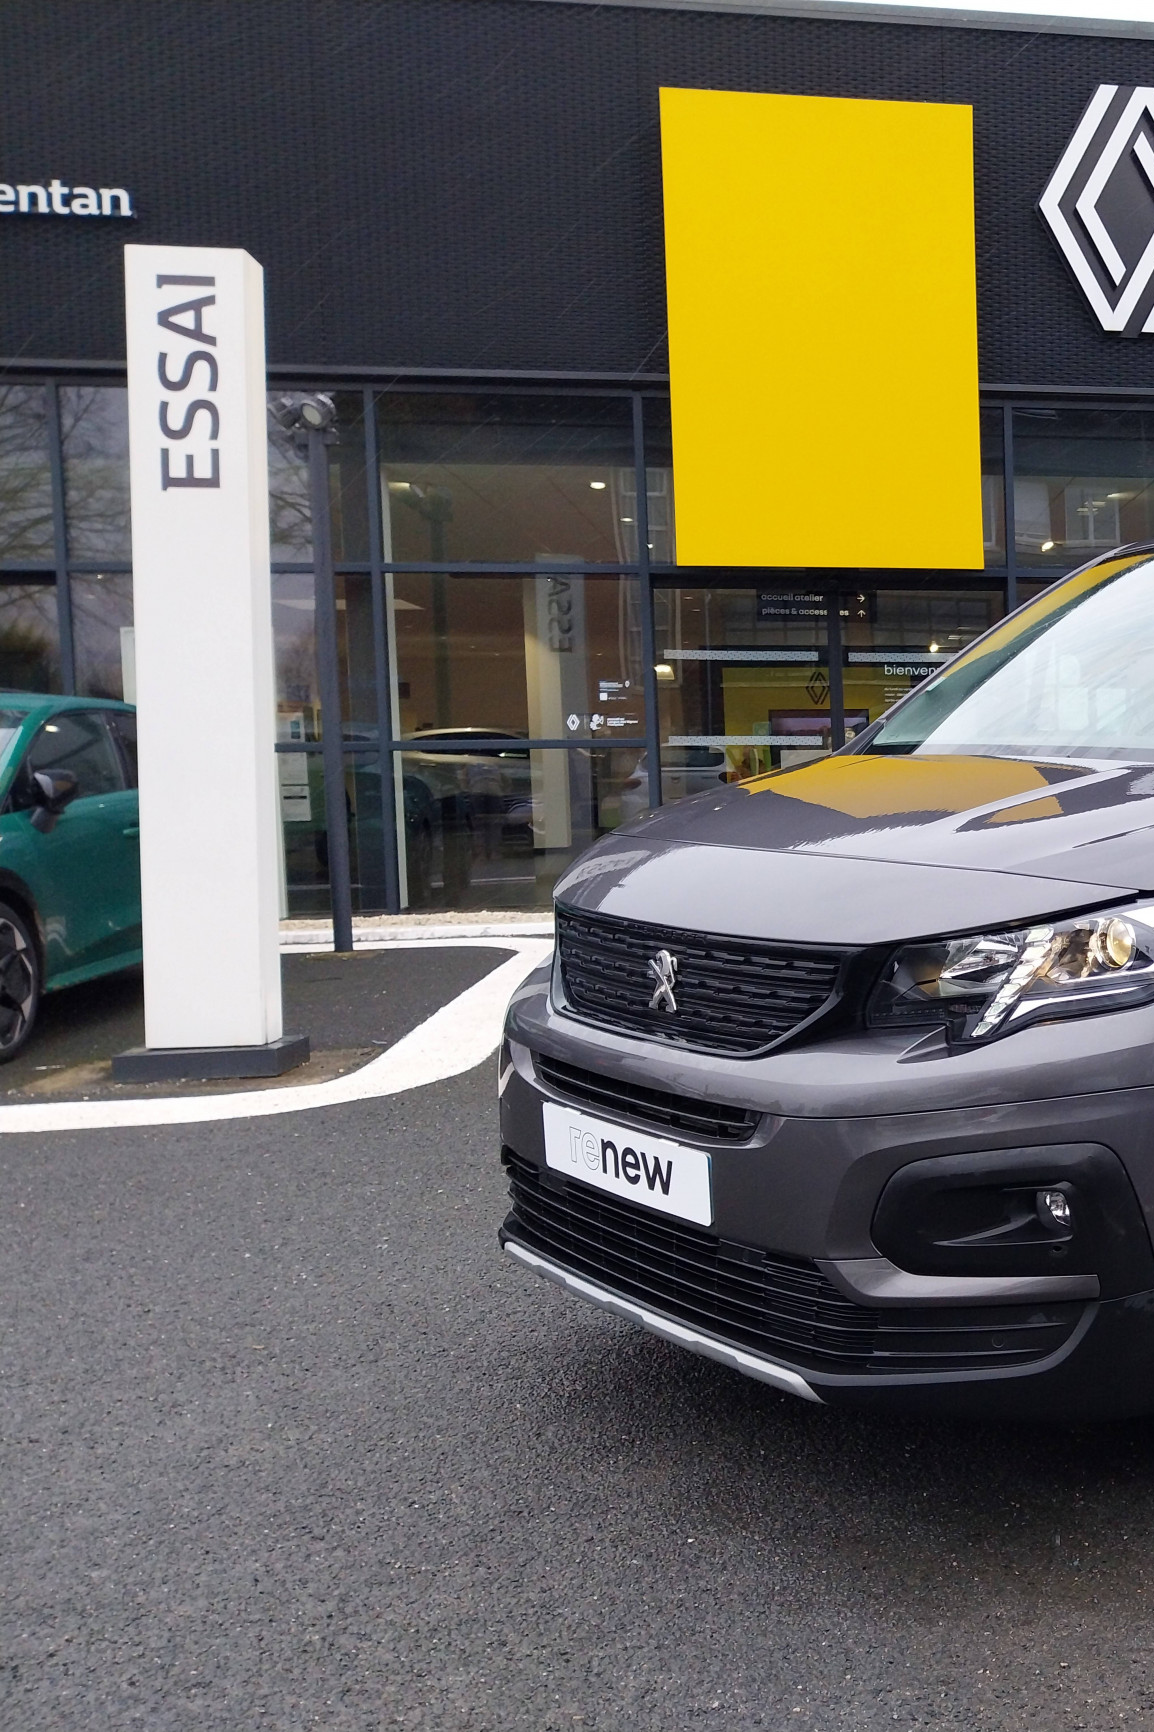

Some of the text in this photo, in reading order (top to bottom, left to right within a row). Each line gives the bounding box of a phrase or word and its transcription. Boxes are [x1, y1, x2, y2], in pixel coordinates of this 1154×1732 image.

[156, 273, 221, 491] ESSAI
[760, 593, 824, 602] accueil atelier
[884, 664, 941, 676] bienven
[568, 1125, 673, 1196] renew
